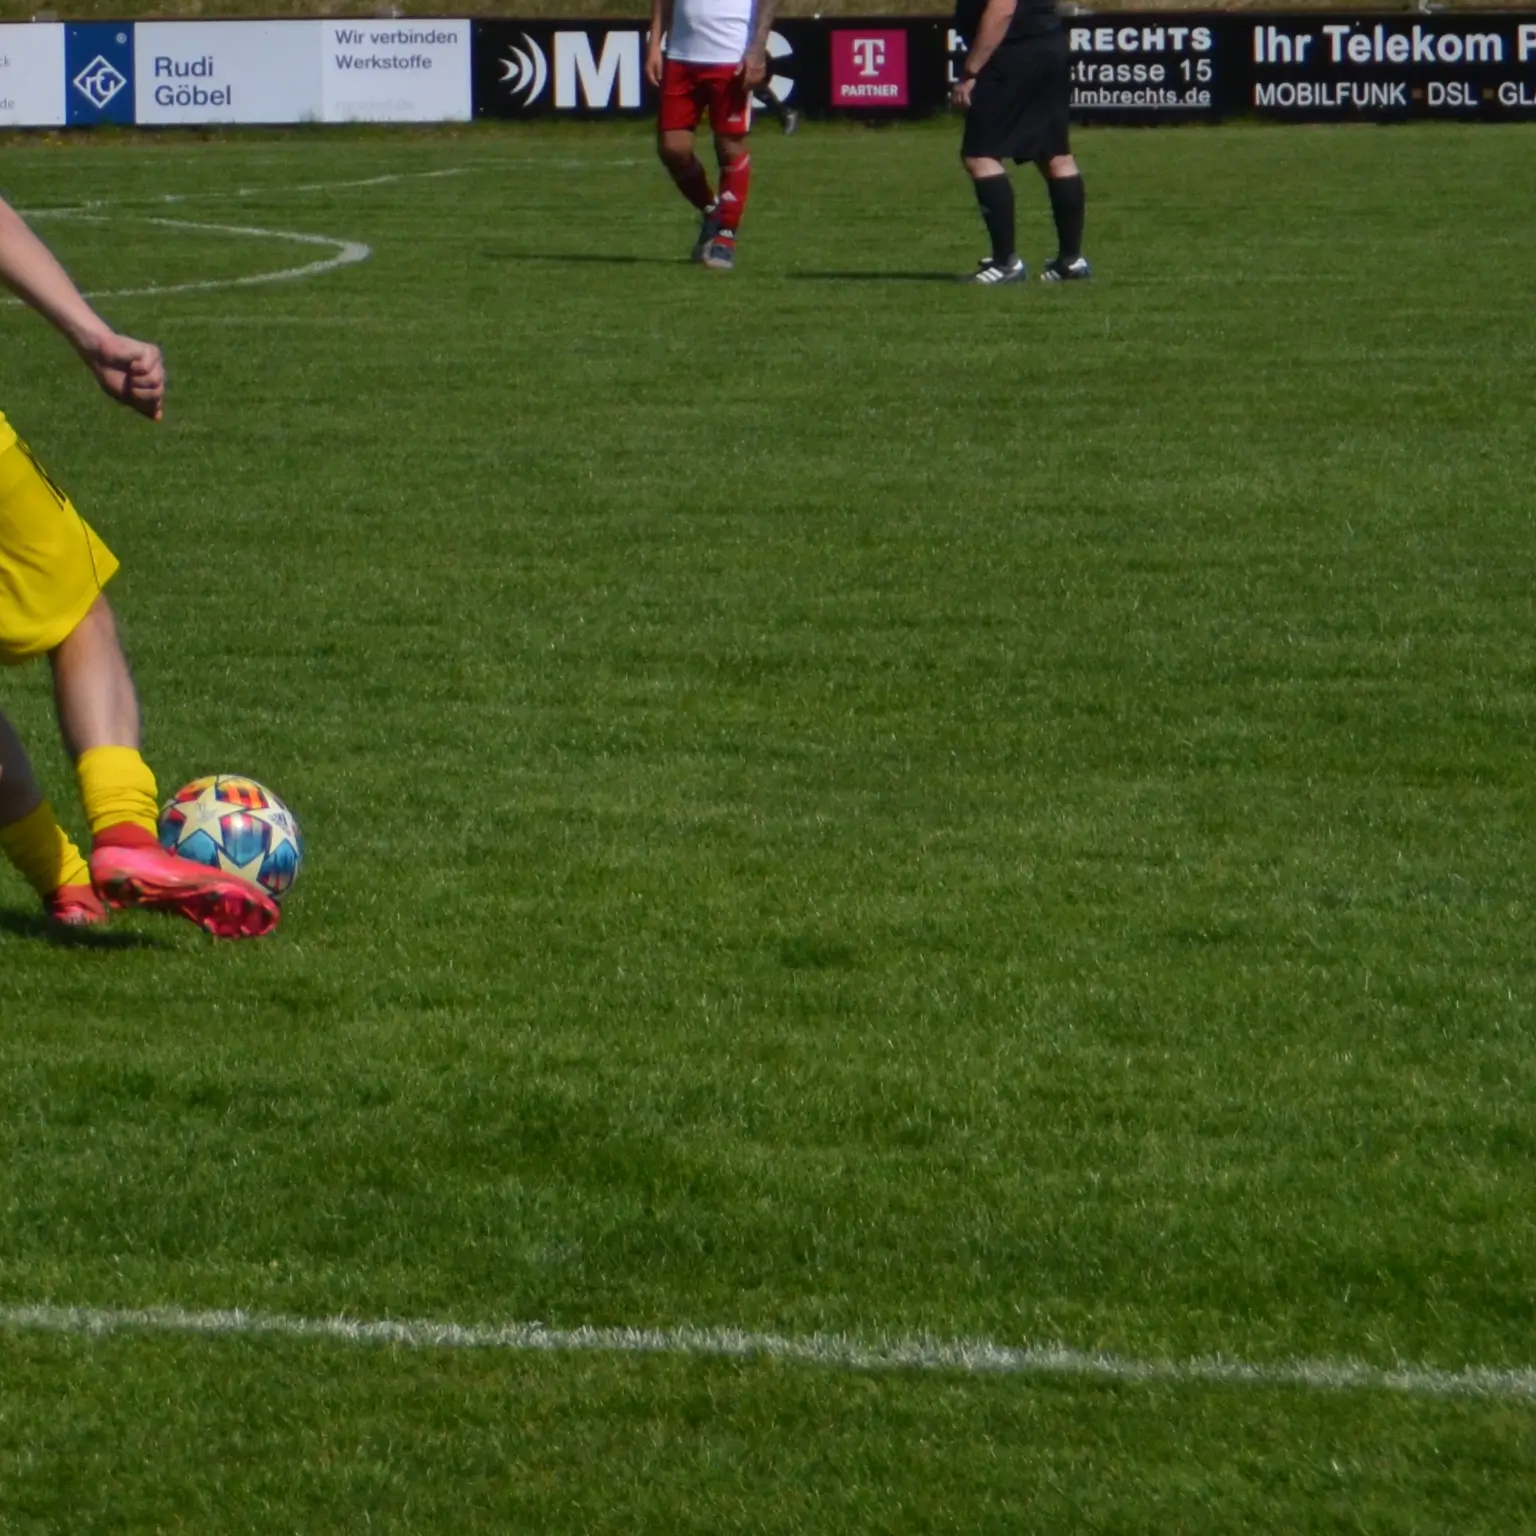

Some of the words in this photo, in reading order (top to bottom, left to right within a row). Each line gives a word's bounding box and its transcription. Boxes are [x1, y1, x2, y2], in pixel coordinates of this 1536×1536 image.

[335, 29, 364, 44] Wir
[370, 29, 458, 44] verbinden
[1070, 27, 1212, 52] RECHTS
[1253, 25, 1311, 62] Ihr
[1322, 24, 1502, 62] Telekom
[154, 56, 213, 77] Rudi
[335, 54, 432, 69] Werkstoffe
[1180, 59, 1213, 82] 15
[154, 84, 231, 106] Göbel
[841, 84, 899, 97] PARTNER
[1255, 82, 1406, 106] MOBILFUNK
[1428, 82, 1477, 106] DSL
[1498, 82, 1536, 106] GL
